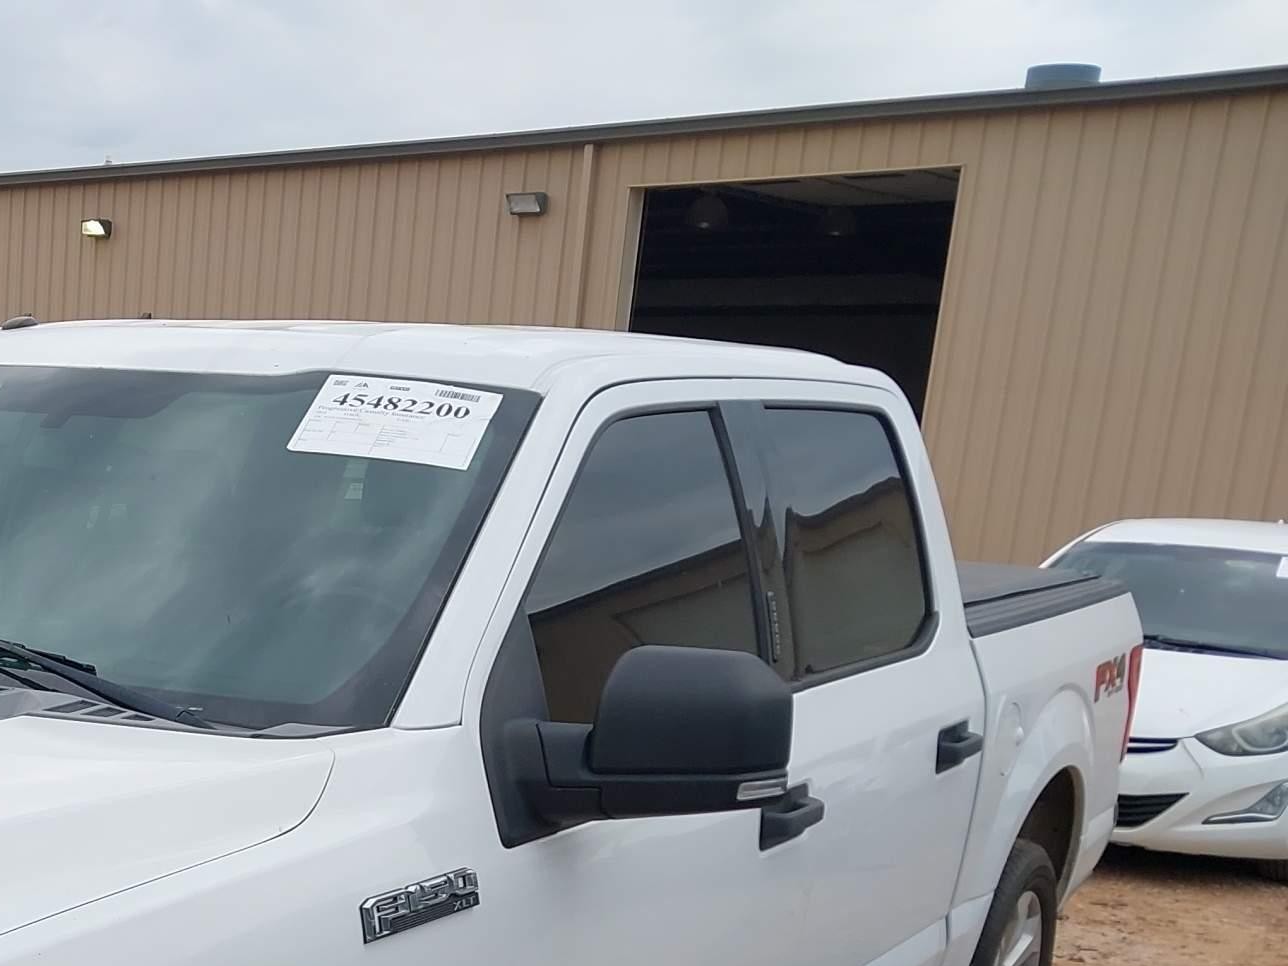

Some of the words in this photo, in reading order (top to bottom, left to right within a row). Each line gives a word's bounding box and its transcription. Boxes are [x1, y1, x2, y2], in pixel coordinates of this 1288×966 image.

[332, 393, 471, 419] 45482200
[1094, 652, 1126, 703] FX4
[453, 896, 478, 911] XLT
